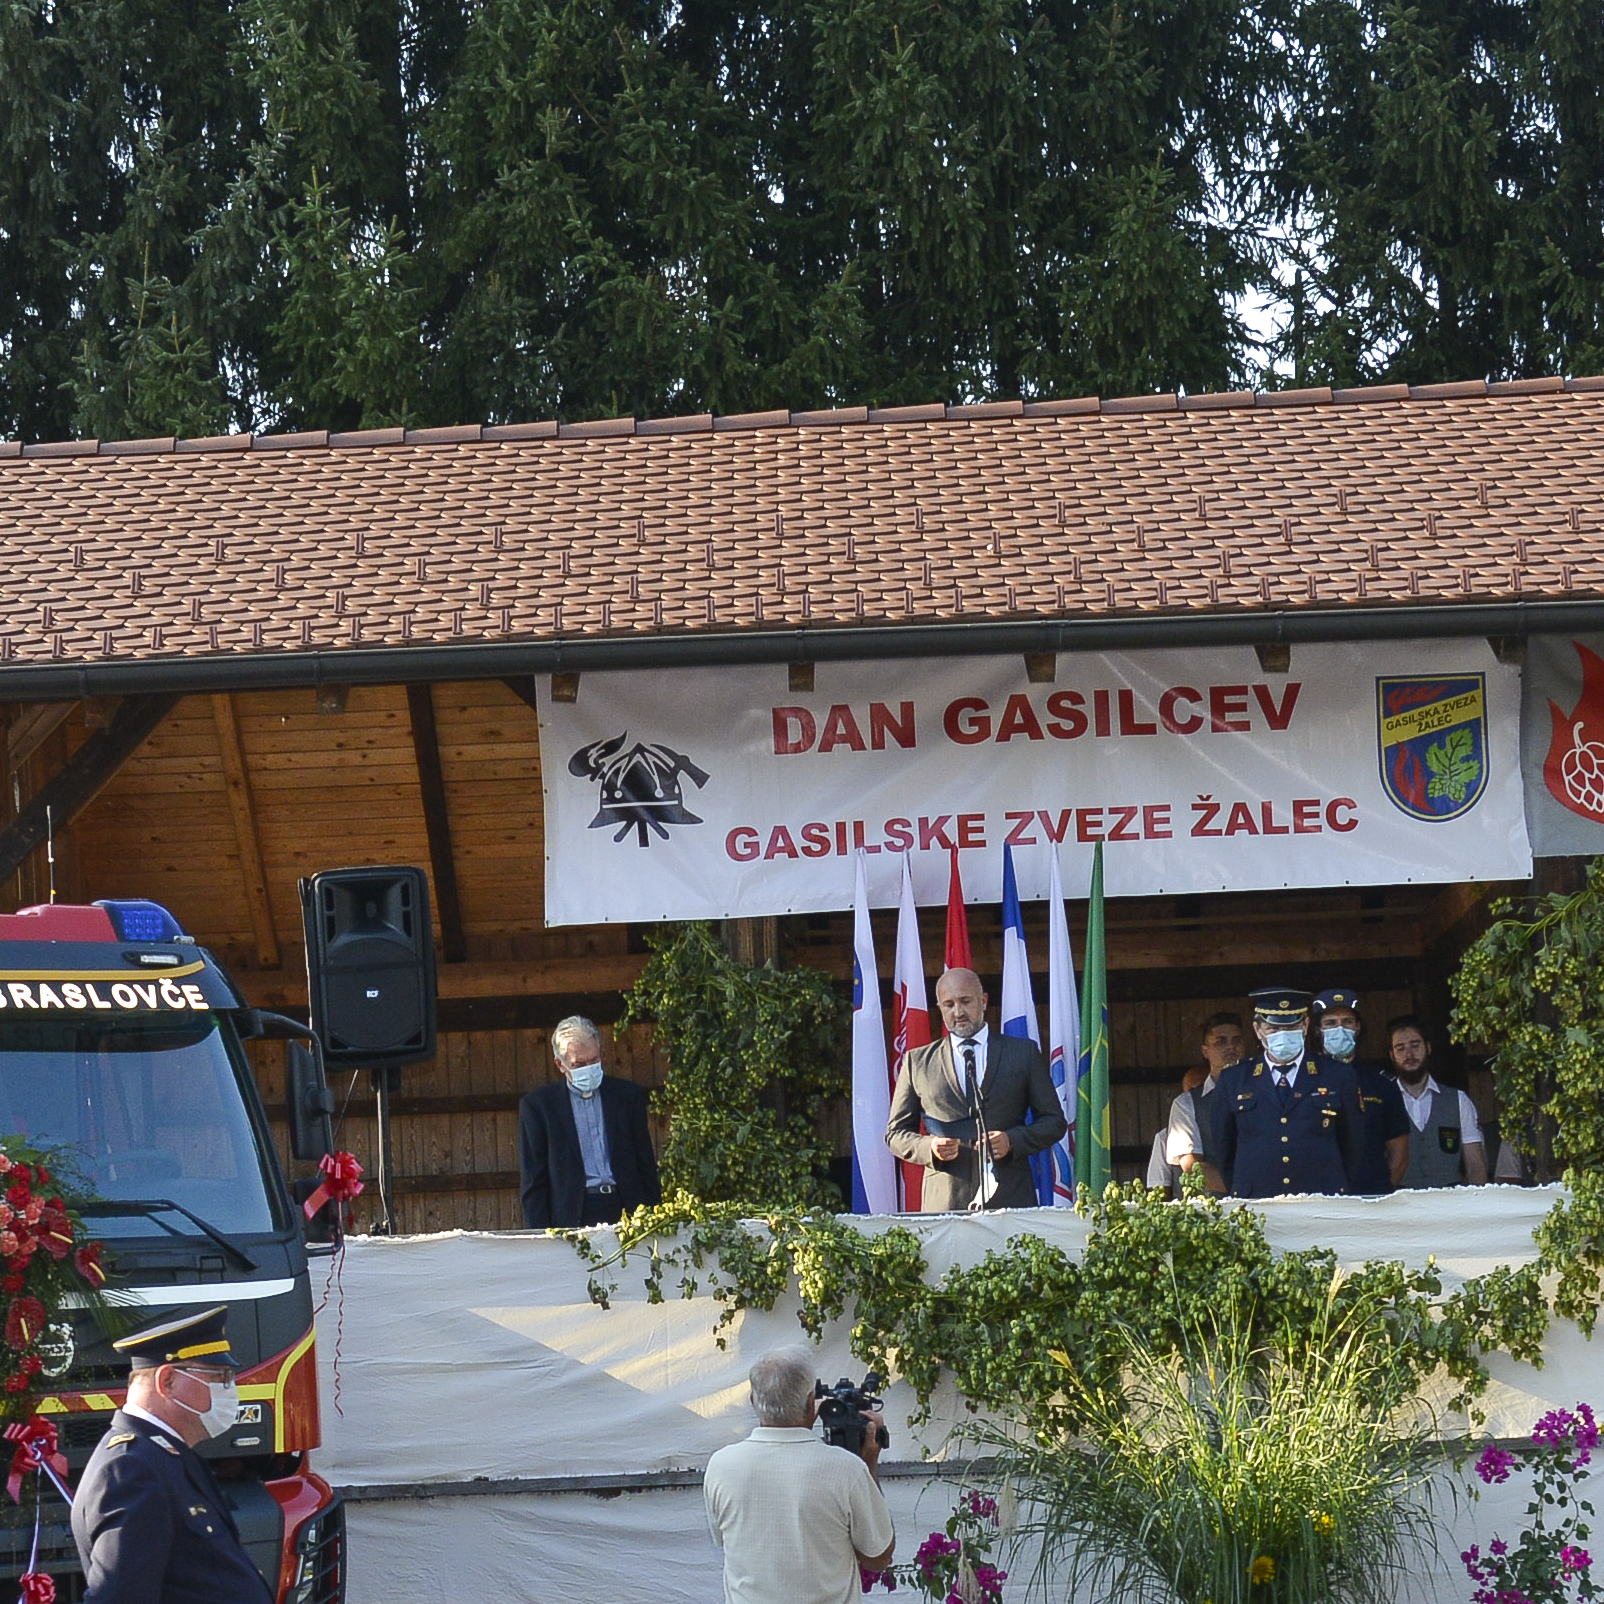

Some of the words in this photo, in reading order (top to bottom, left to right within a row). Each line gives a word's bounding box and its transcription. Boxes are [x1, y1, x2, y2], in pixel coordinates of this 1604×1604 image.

[772, 700, 917, 755] DAN
[942, 681, 1302, 745] GASILCEV
[1386, 707, 1441, 731] GASILSKA
[1441, 695, 1477, 713] ZVEZA
[1417, 713, 1453, 733] ŽALEC
[725, 813, 988, 862] GASILSKE
[1004, 803, 1173, 846] ZVEZE
[1190, 794, 1361, 838] ŽALEC
